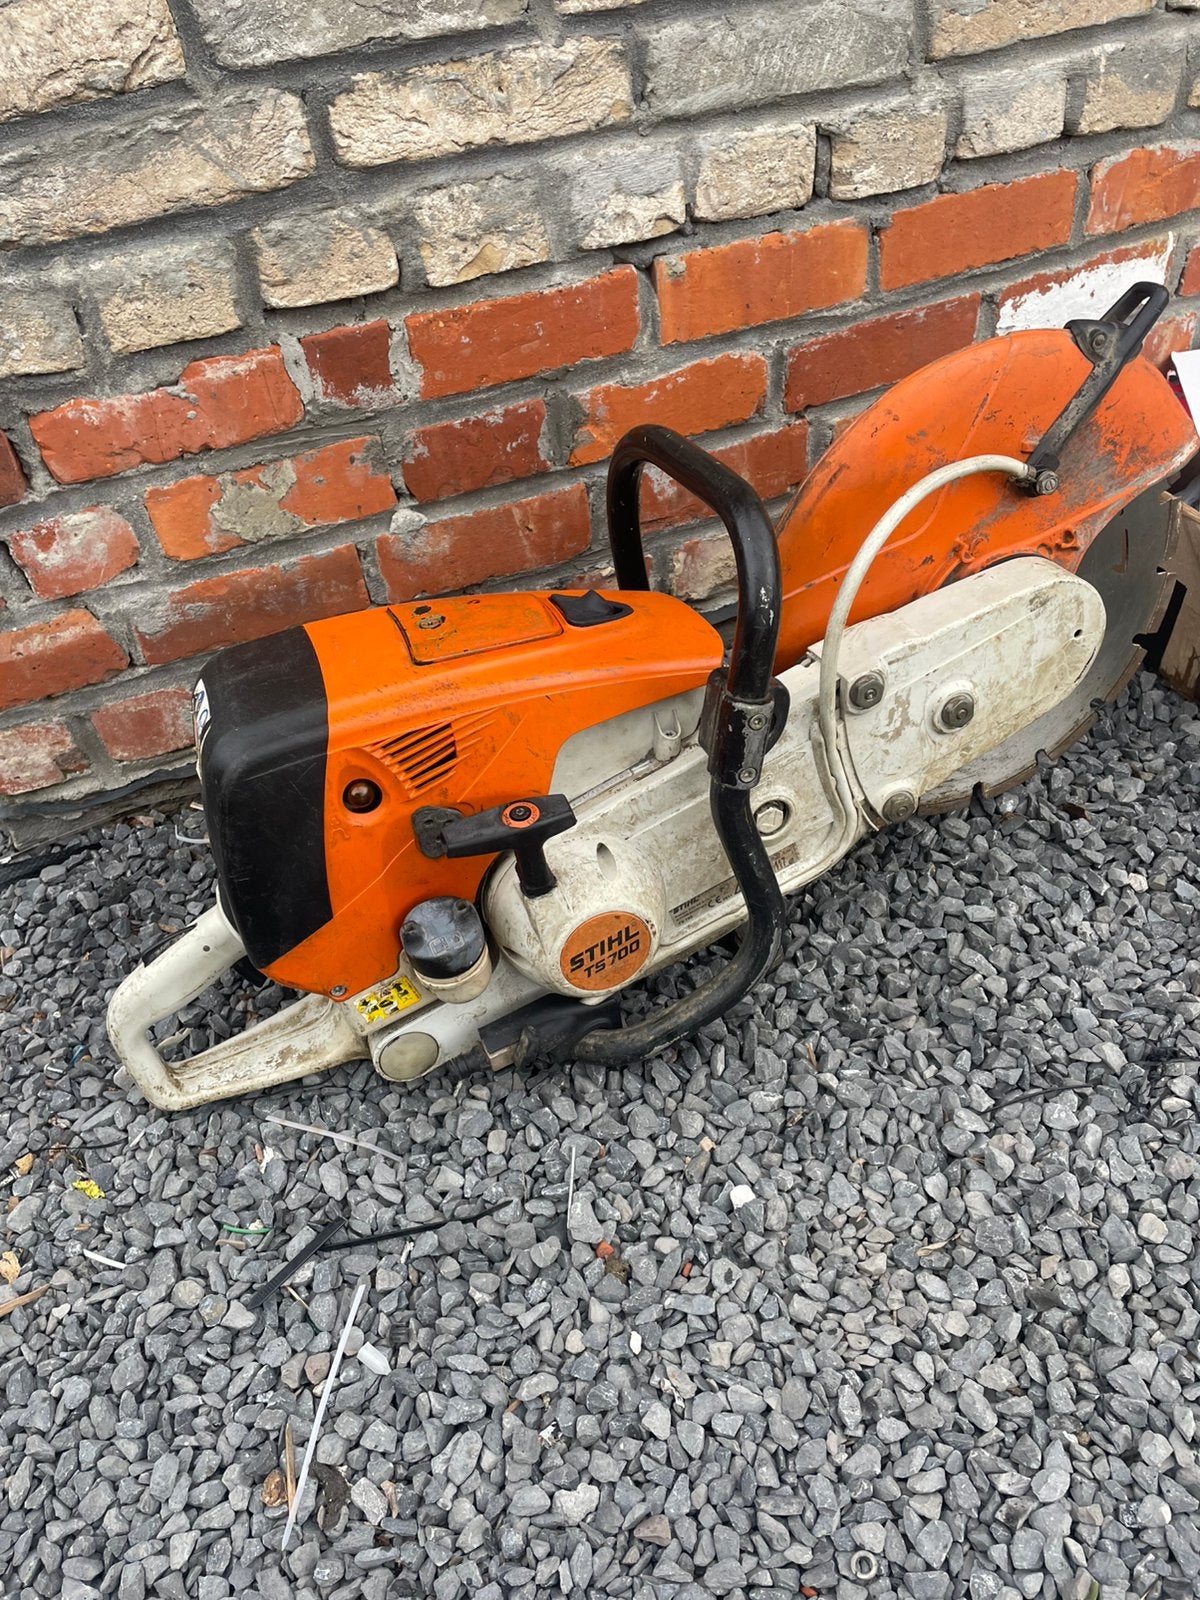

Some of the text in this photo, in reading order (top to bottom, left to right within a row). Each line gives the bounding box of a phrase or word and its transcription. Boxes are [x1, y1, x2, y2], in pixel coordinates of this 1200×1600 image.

[569, 925, 640, 973] STIHL
[583, 938, 640, 978] TS 700
